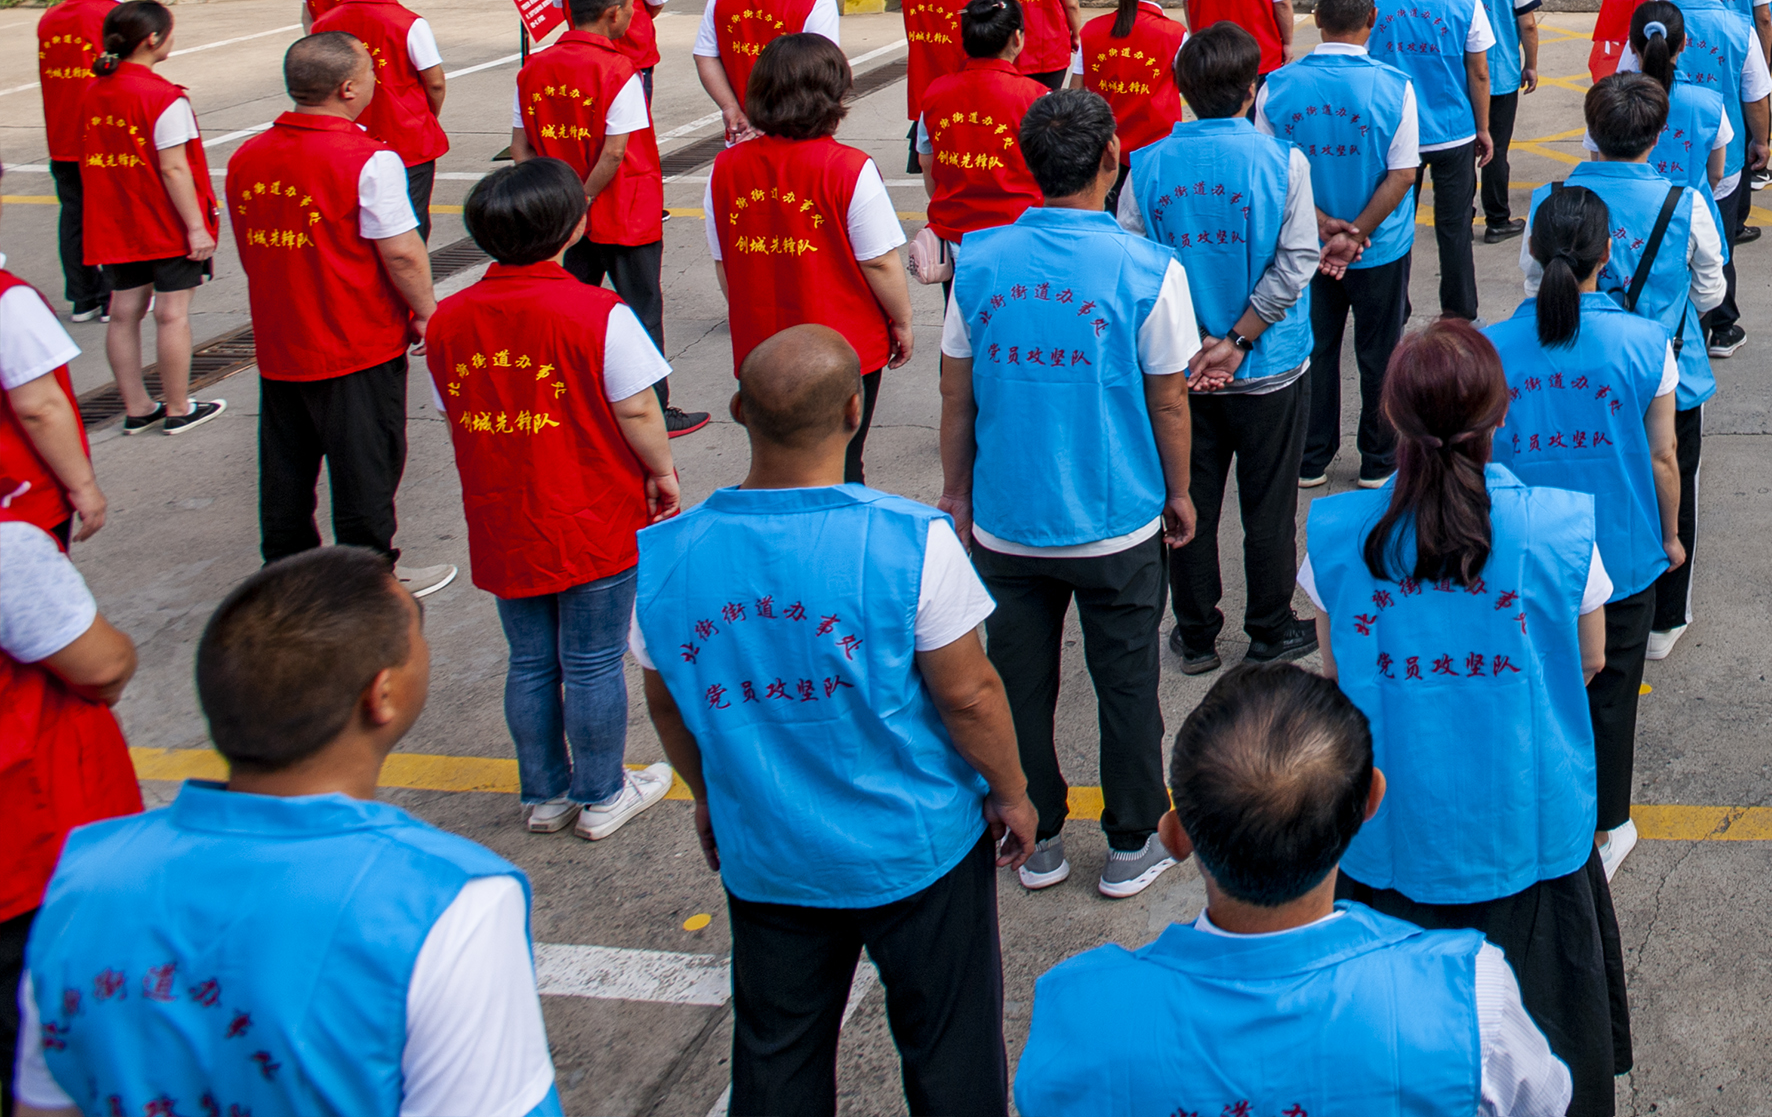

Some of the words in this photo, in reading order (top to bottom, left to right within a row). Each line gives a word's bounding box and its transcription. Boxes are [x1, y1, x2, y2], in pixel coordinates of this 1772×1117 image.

[735, 234, 819, 258] 创城先锋队
[978, 281, 1109, 338] 北街街道办事处
[987, 343, 1092, 368] 党员攻坚队
[447, 349, 567, 400] 北街街道办事处
[680, 594, 864, 665] 北街街道办事处
[1376, 651, 1522, 681] 党员攻坚队
[704, 674, 855, 711] 党员攻坚队
